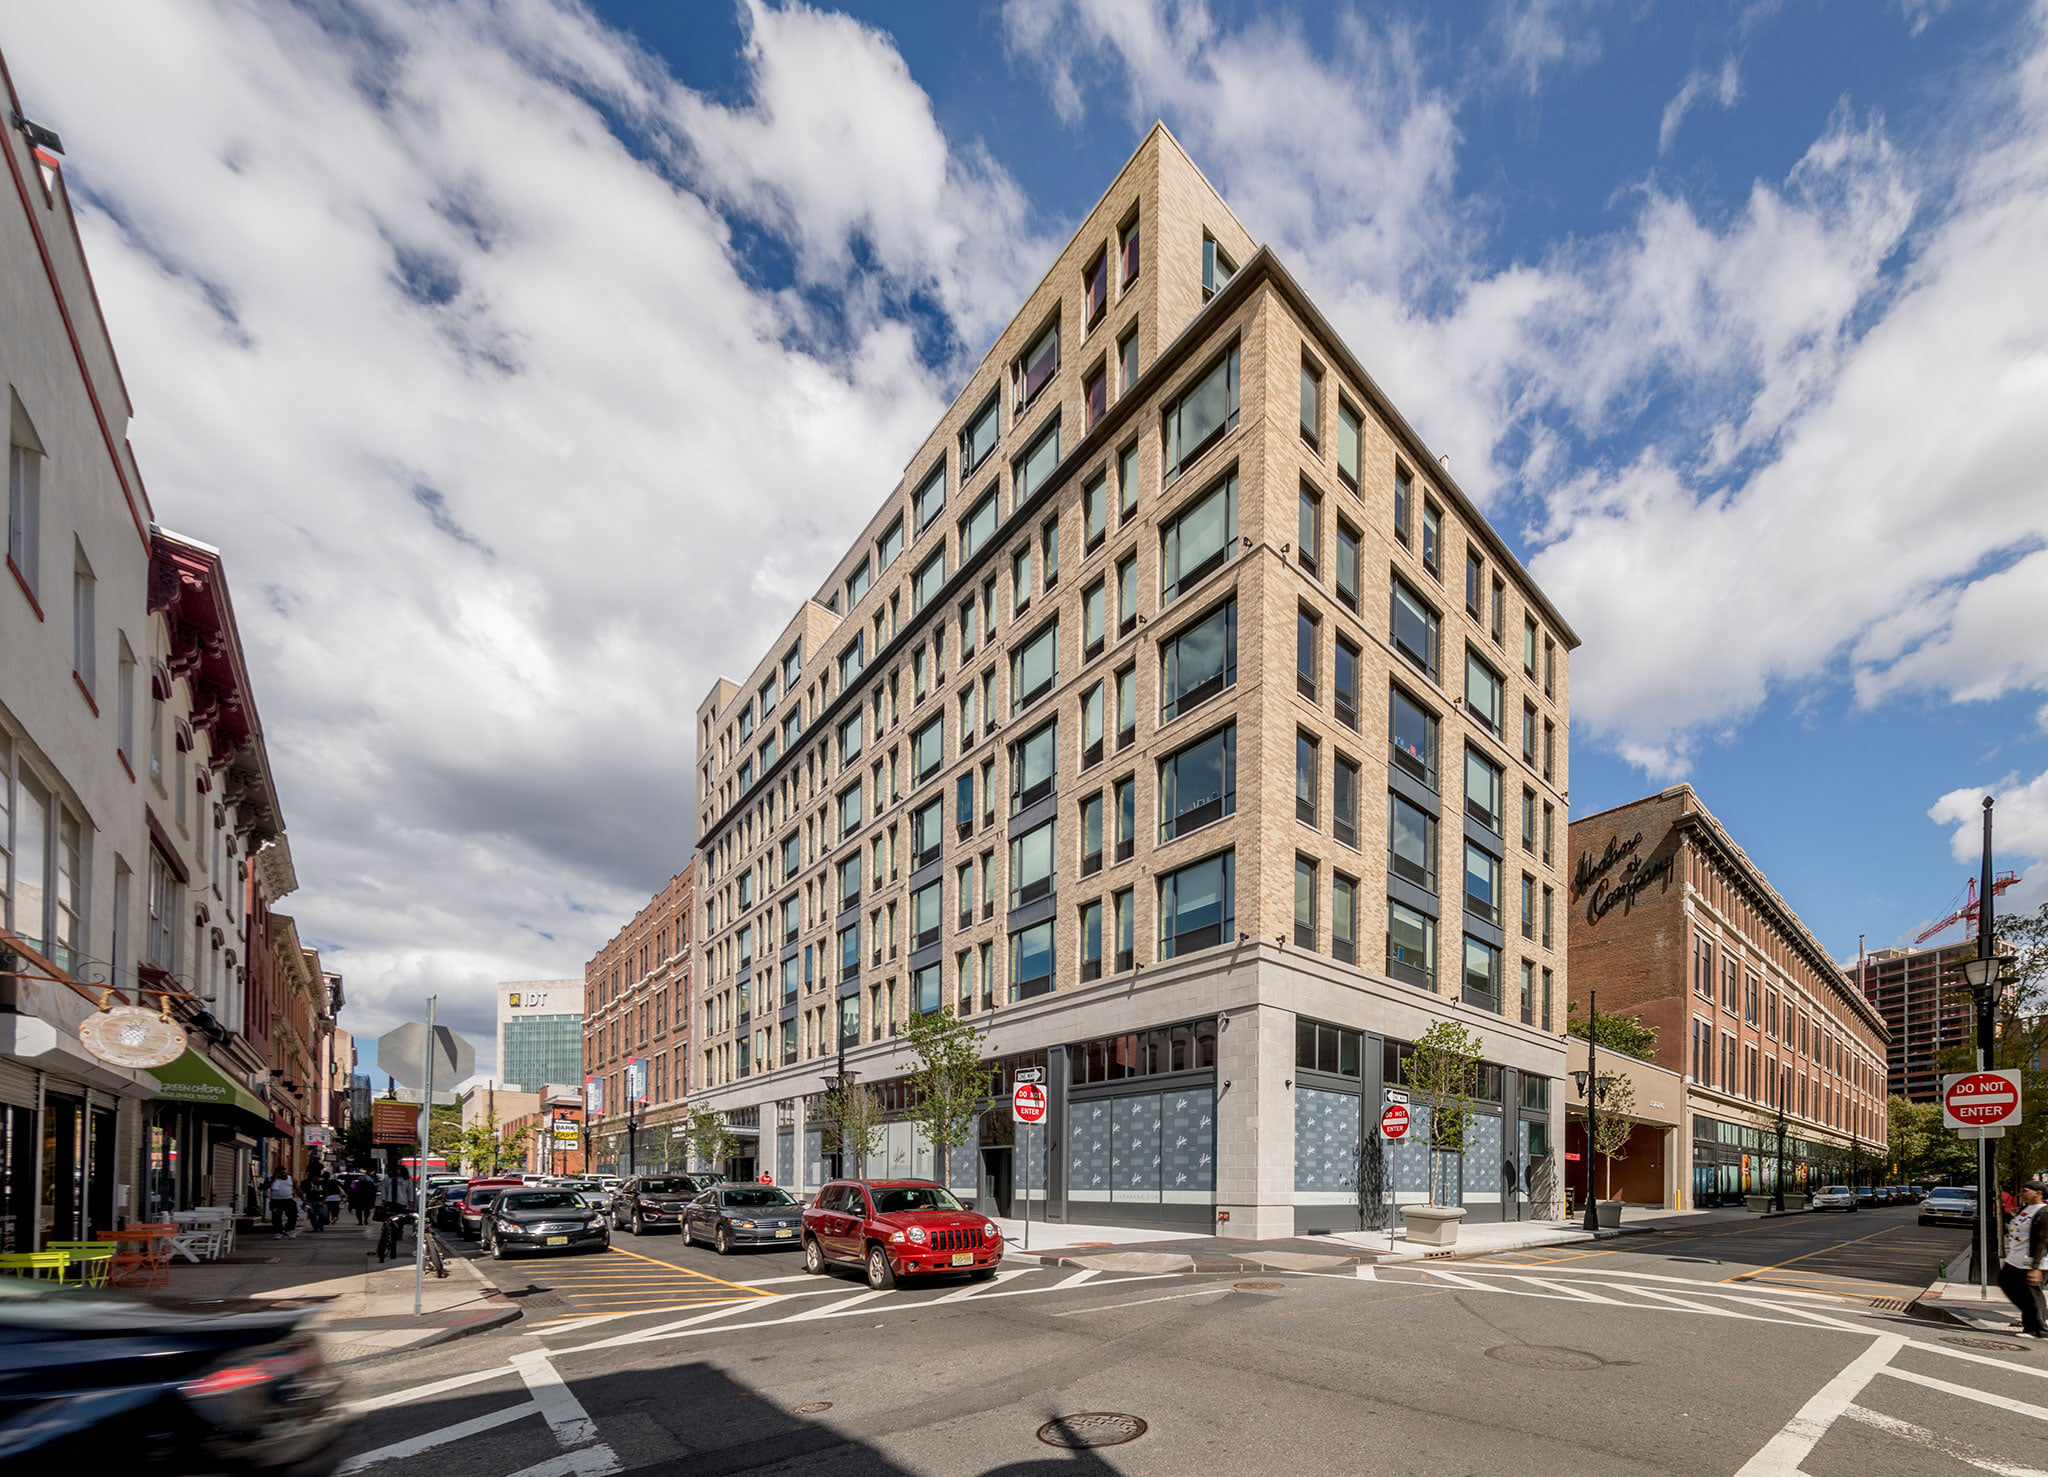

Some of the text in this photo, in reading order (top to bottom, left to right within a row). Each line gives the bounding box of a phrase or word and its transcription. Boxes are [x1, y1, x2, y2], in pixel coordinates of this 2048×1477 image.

[524, 992, 547, 1007] IDT
[160, 1083, 191, 1092] GREEN
[1956, 1081, 2006, 1094] DO NOT
[1018, 1090, 1028, 1098] DO
[1020, 1107, 1040, 1116] ENTER
[1960, 1105, 2003, 1117] ENTER
[1386, 1125, 1404, 1133] ENTER
